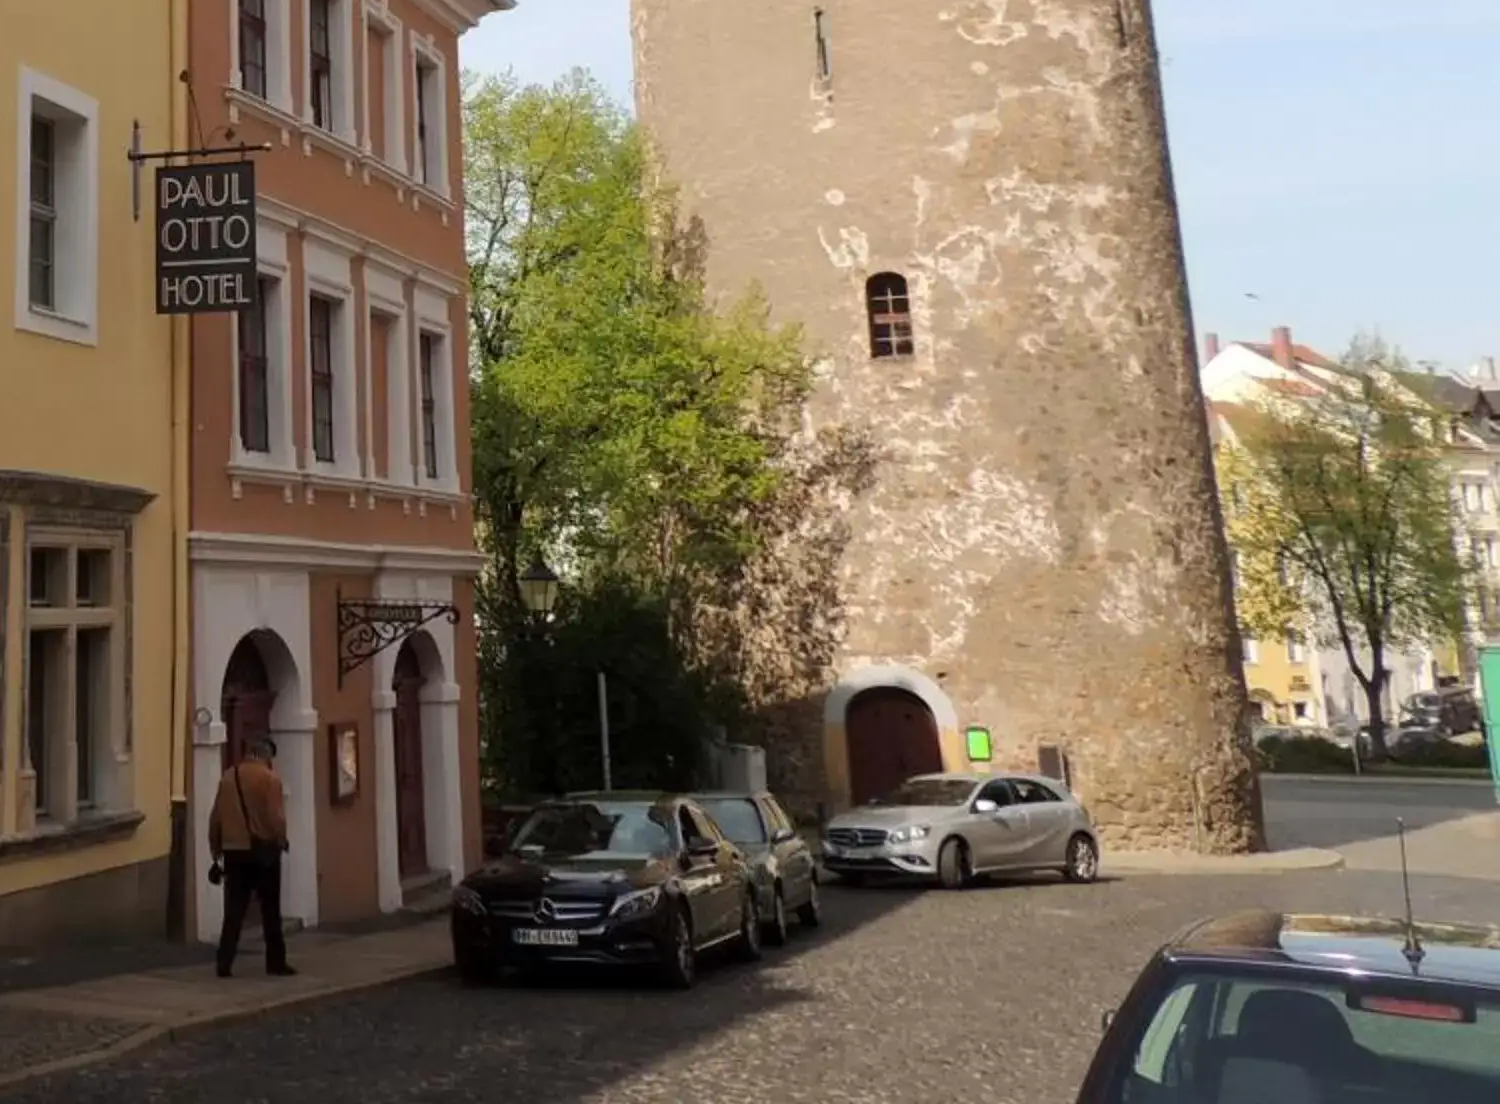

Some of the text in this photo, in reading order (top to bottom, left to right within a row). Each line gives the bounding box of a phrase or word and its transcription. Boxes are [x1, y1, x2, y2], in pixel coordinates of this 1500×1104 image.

[161, 172, 249, 209] PAUL
[161, 215, 249, 252] OTTO
[161, 273, 251, 307] HOTEL
